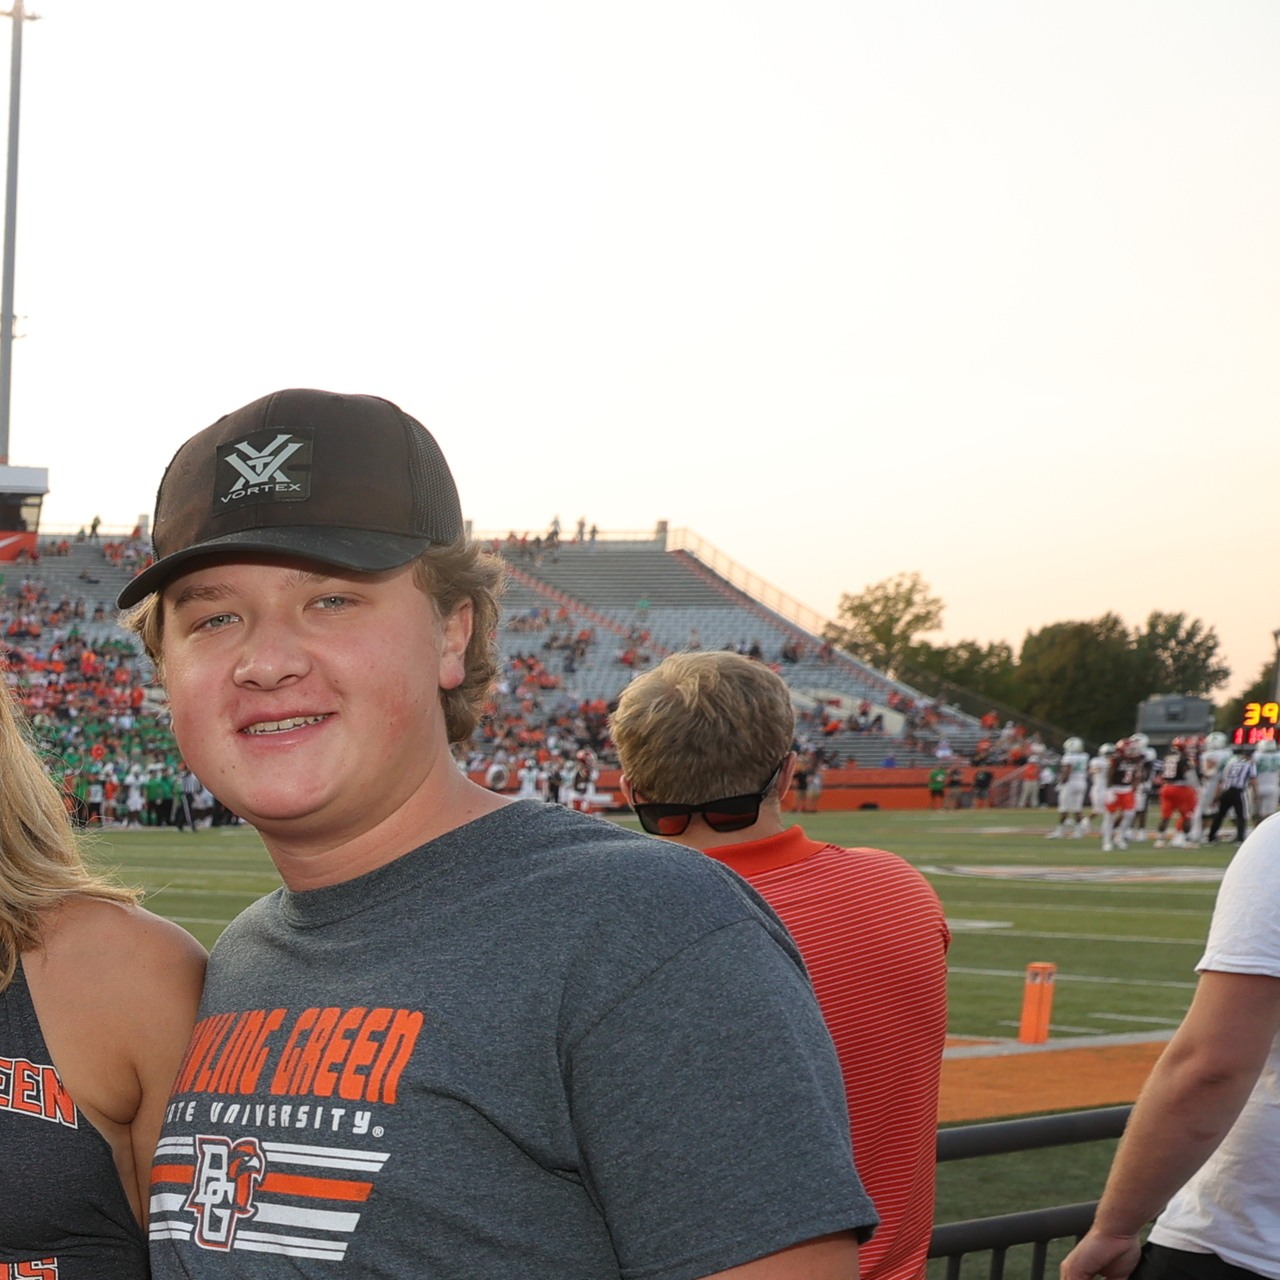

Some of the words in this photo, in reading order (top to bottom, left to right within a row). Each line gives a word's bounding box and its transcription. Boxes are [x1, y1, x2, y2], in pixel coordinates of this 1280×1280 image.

[220, 483, 301, 503] VORTEX
[1243, 702, 1279, 726] 39
[270, 1007, 425, 1105] GREEN
[209, 1102, 372, 1134] UNIVERSITY
